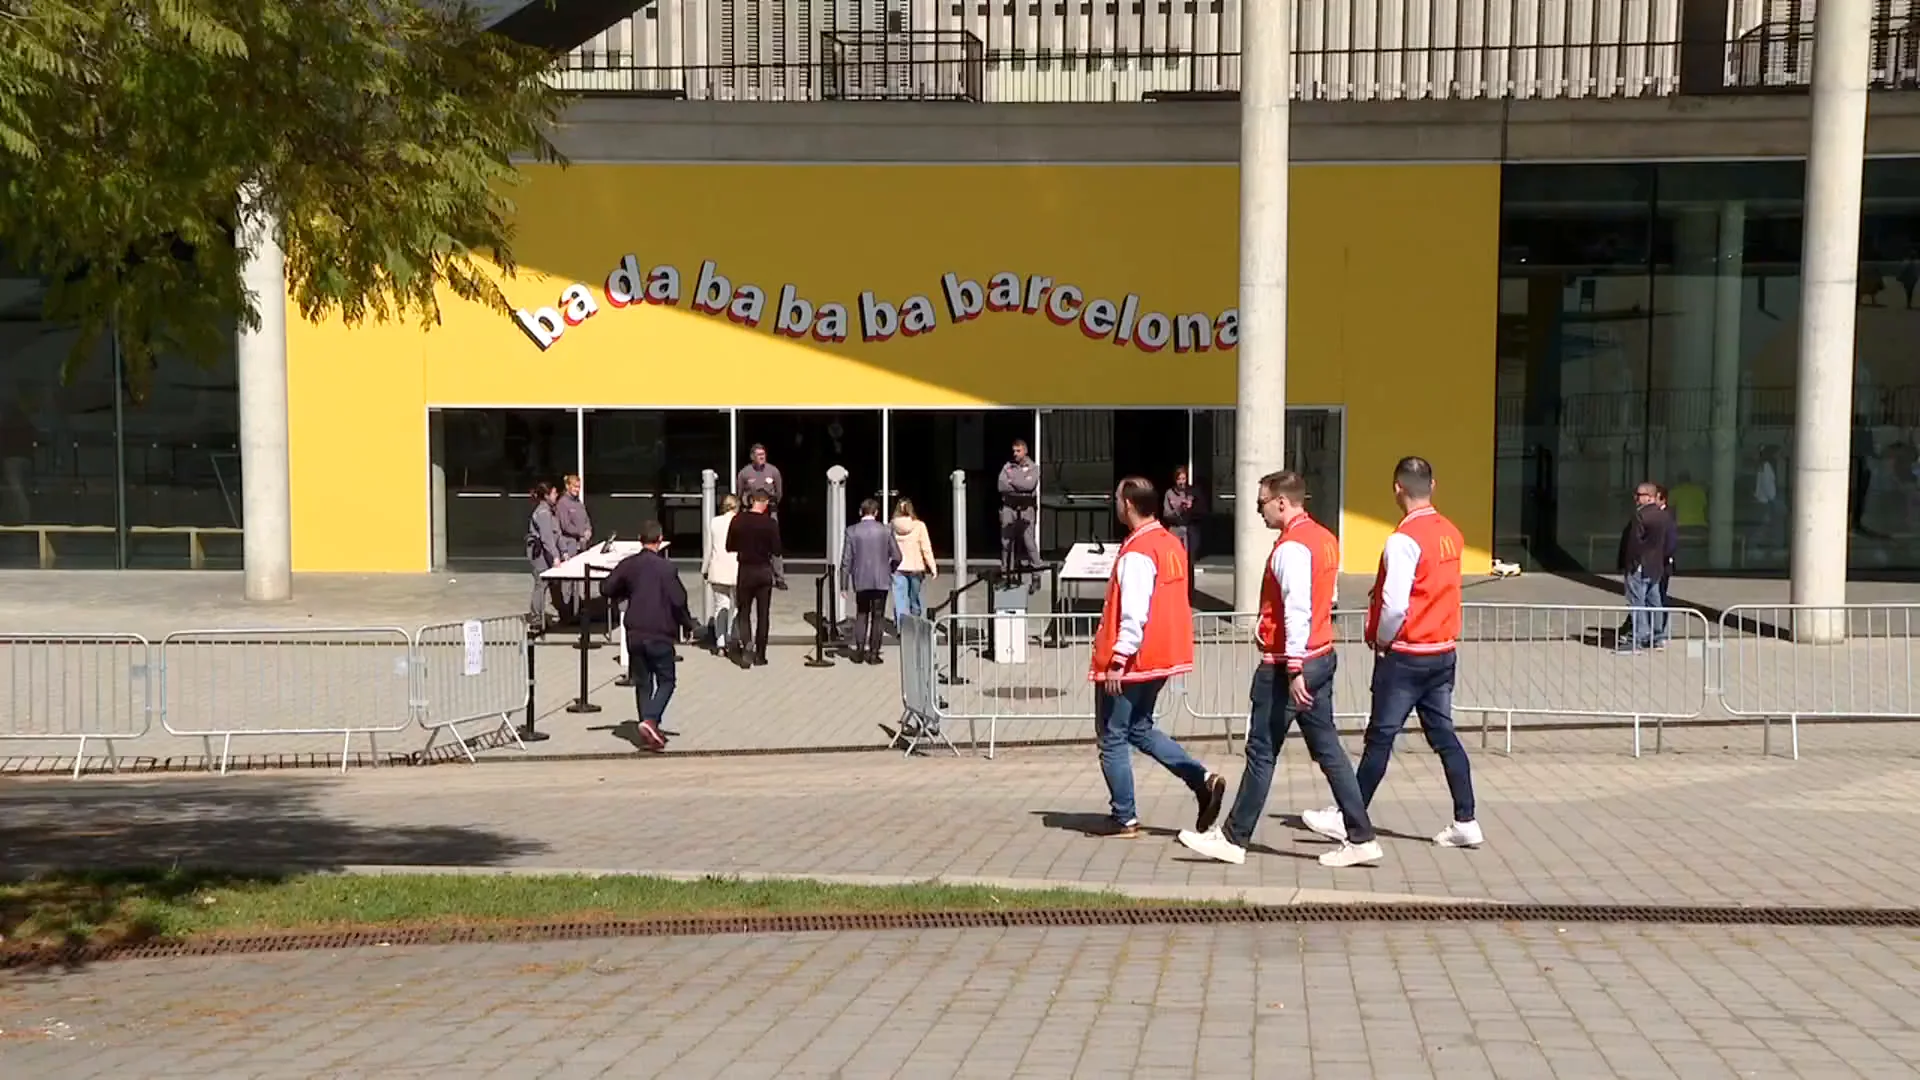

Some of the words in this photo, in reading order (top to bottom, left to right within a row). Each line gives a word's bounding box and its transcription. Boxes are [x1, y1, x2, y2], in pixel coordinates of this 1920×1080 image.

[515, 283, 599, 352] ba
[604, 253, 681, 308] da
[691, 259, 767, 328] ba
[773, 283, 848, 343] ba
[857, 290, 936, 343] ba
[940, 271, 1239, 353] barcelona
